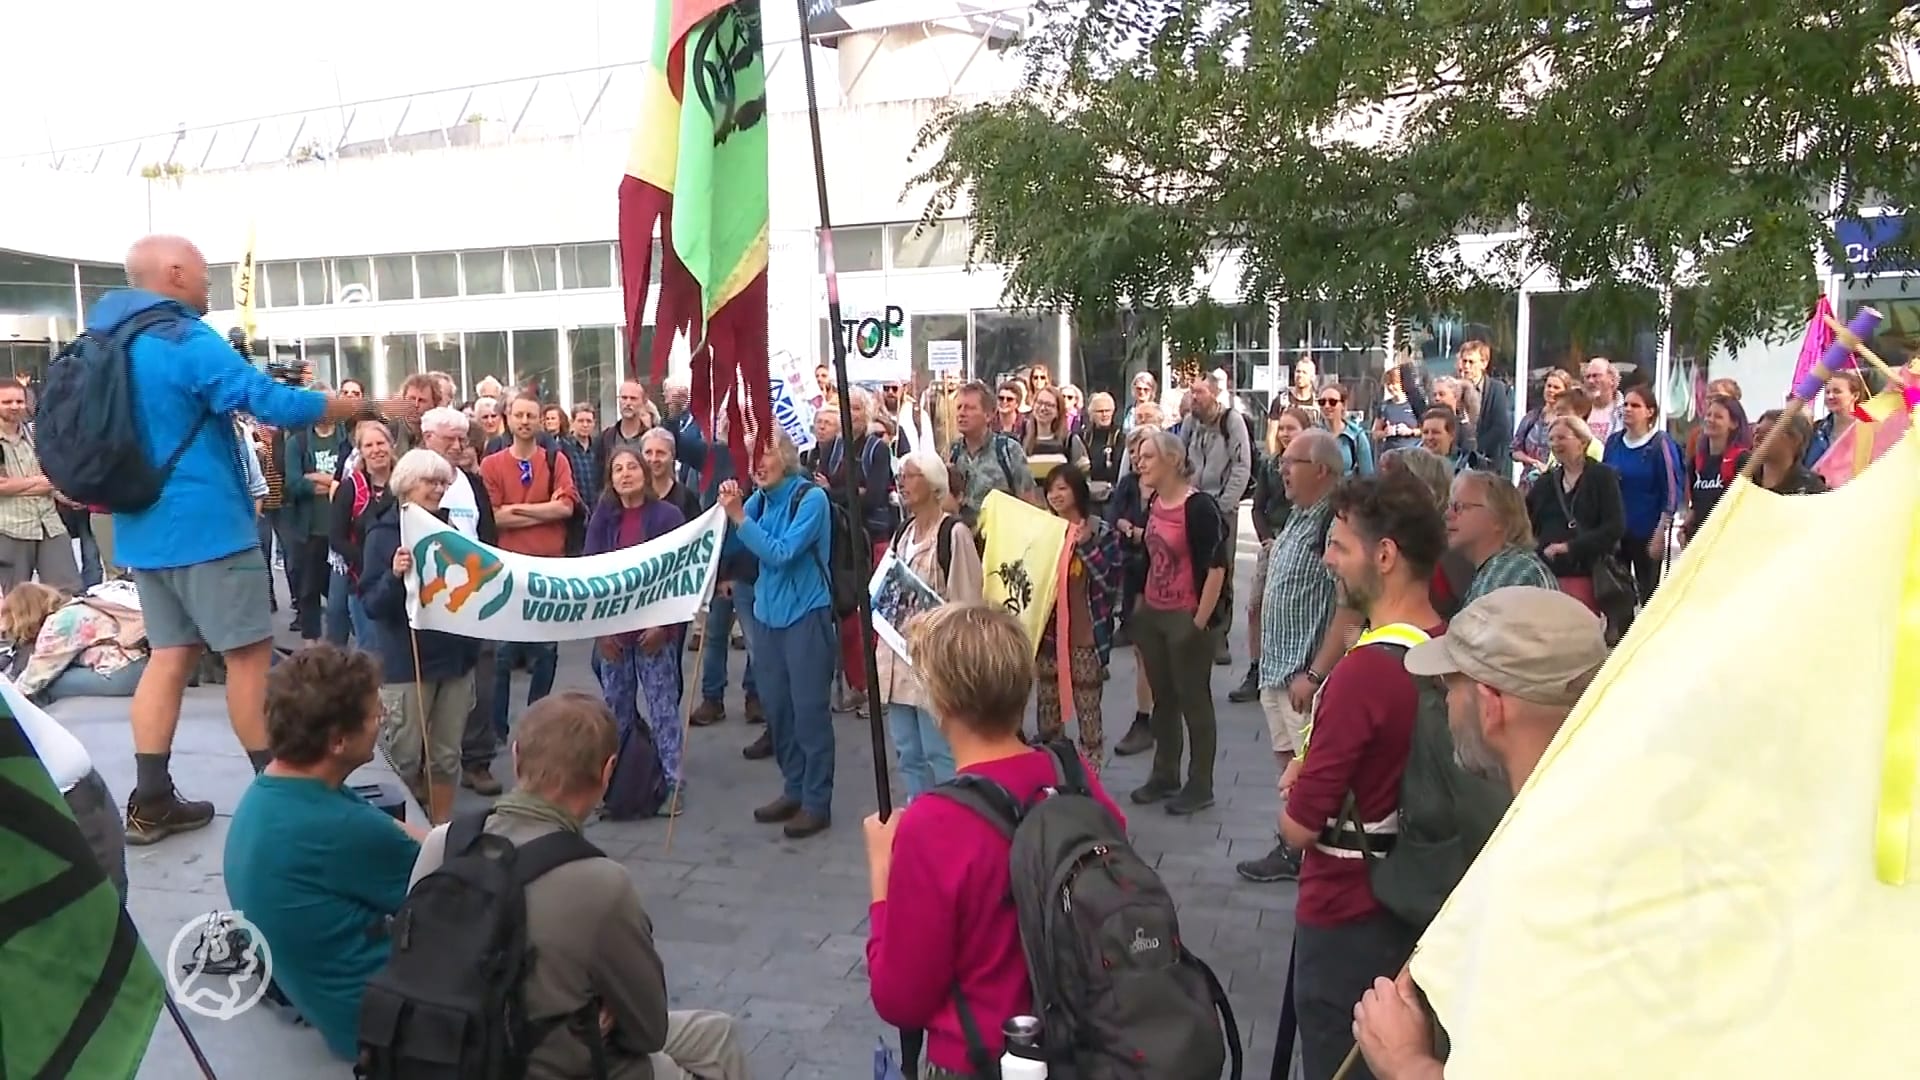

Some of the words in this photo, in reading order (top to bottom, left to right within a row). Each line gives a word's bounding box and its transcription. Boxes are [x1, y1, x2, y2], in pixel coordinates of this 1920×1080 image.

[840, 305, 904, 358] TOP
[528, 530, 714, 600] GROOTOUDERS
[522, 599, 587, 622] VOOR
[592, 595, 635, 620] HET
[634, 567, 708, 610] KLIMAA
